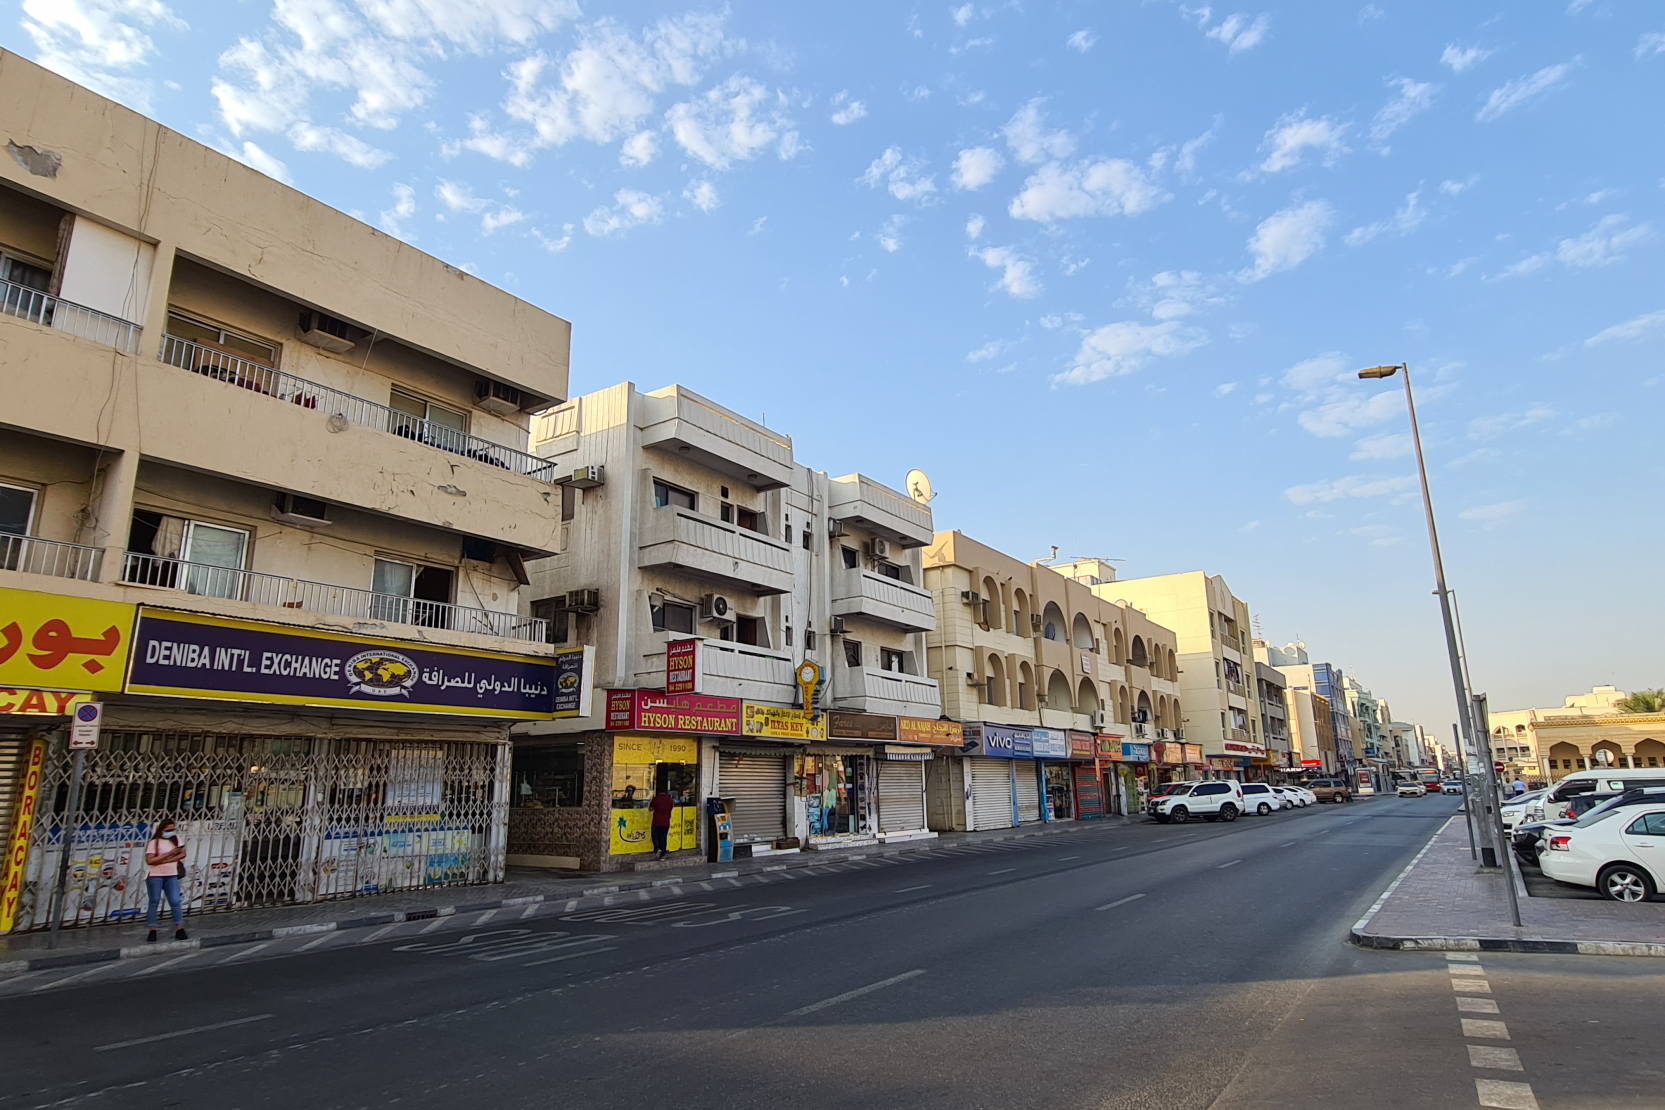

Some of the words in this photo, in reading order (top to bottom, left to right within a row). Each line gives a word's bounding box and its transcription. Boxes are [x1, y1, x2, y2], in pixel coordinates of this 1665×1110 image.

[146, 639, 210, 669] DENIBA
[213, 646, 256, 673] INT'L.
[260, 651, 341, 681] EXCHANGE
[360, 651, 400, 660] INTERNATIONAL
[401, 657, 417, 682] EXCHANGE
[669, 655, 694, 670] HYSON
[421, 666, 475, 690] للصرافة
[476, 674, 519, 698] الدولي
[520, 677, 548, 698] دنيبا
[610, 699, 631, 711] HYSON
[693, 700, 737, 714] مطعم
[641, 712, 676, 728] HYSON
[678, 715, 737, 731] RESTAURANT
[770, 719, 789, 731] ILYAS
[790, 721, 804, 732] KEY
[618, 743, 643, 751] SINCE
[988, 732, 1013, 749] vivo
[6, 746, 42, 919] BORACAY
